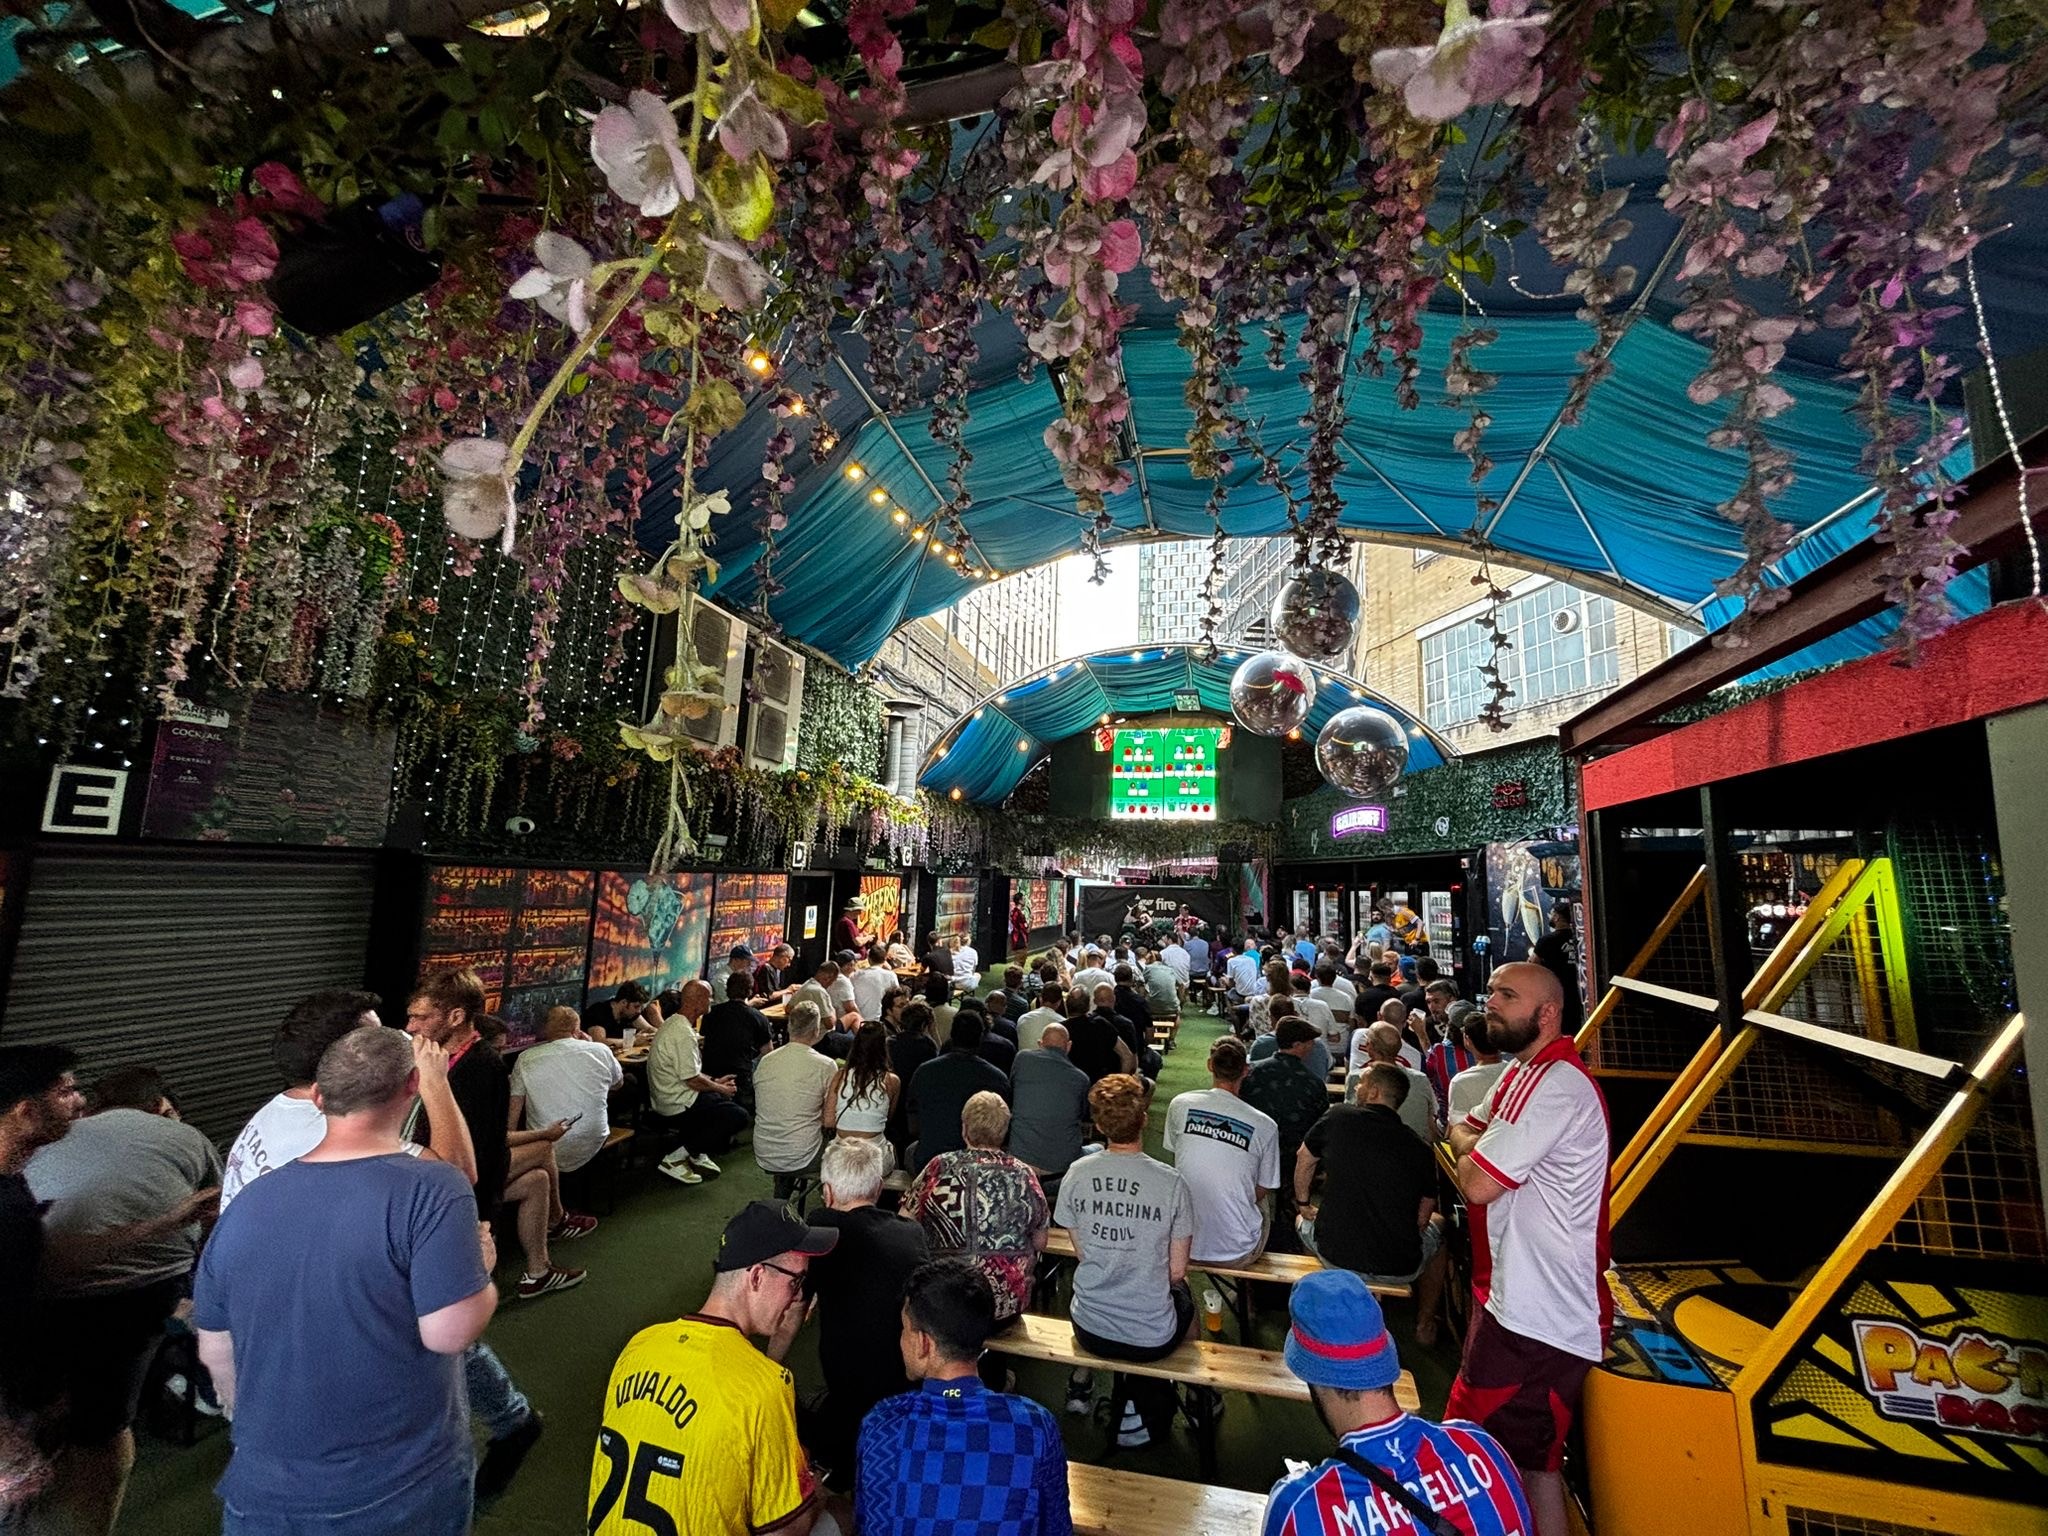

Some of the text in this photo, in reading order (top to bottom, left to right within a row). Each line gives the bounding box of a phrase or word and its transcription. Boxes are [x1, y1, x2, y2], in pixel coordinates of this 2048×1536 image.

[51, 772, 117, 829] E
[795, 844, 805, 864] D
[1156, 897, 1177, 911] fire
[1187, 1122, 1247, 1148] patagonia
[1093, 1177, 1140, 1196] DEUS
[1093, 1201, 1162, 1222] MACHINA
[1091, 1222, 1135, 1241] SEOUL
[616, 1370, 698, 1430] VIVALDO
[588, 1426, 686, 1536] 25
